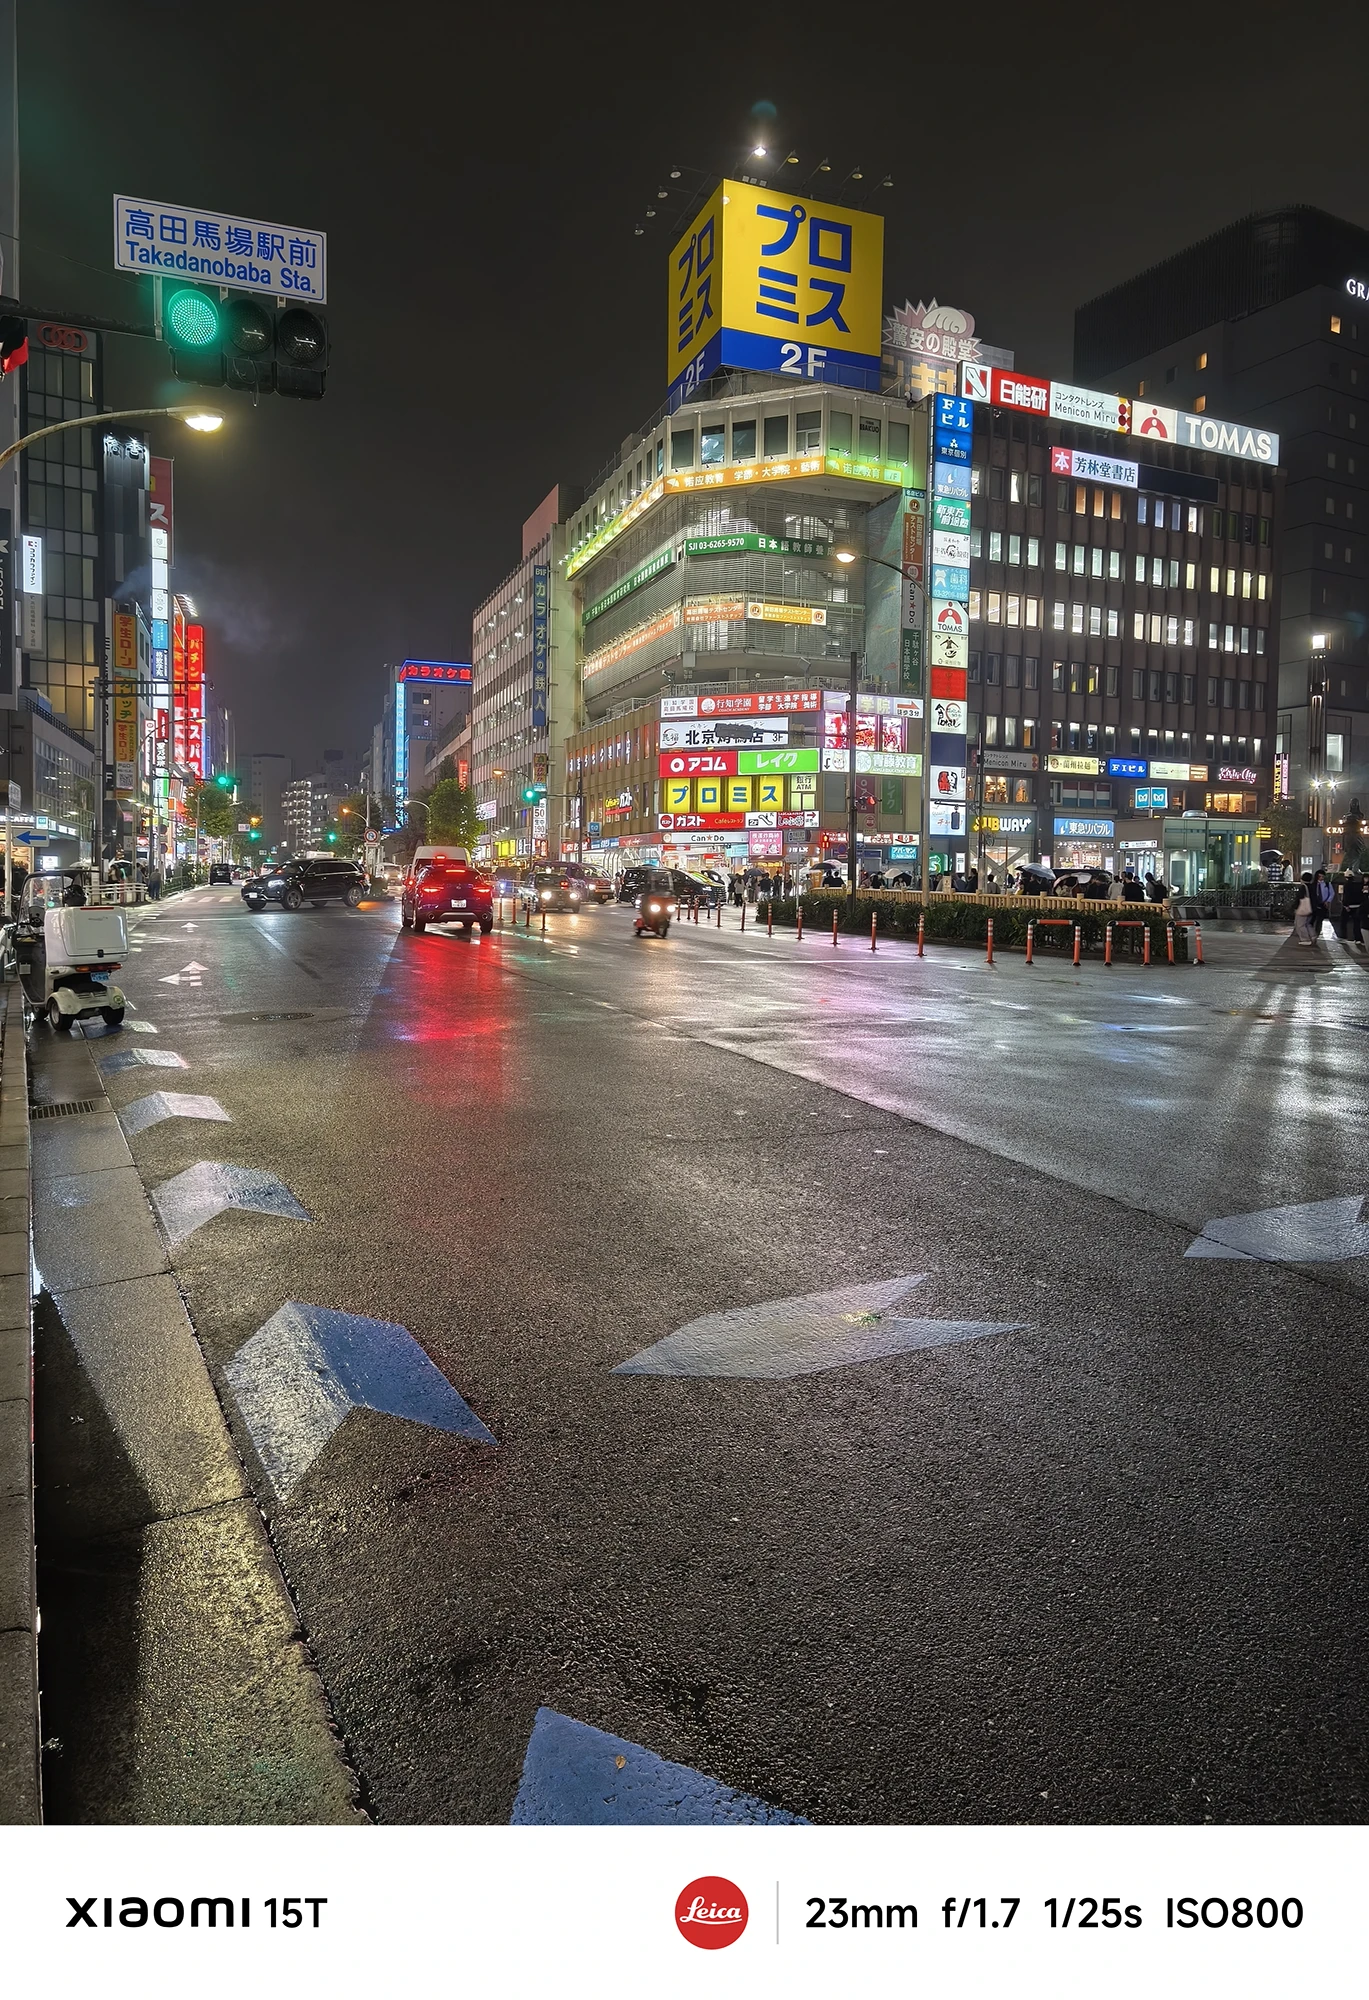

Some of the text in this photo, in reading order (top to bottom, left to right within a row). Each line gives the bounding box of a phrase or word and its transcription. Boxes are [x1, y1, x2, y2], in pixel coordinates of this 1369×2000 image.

[125, 208, 318, 269] 高田馬場駅前
[756, 204, 853, 273] プロ
[125, 240, 317, 295] Takadanobaba Sta.
[678, 215, 715, 301] プロ
[756, 266, 852, 334] ミス
[678, 276, 714, 353] ミス
[891, 321, 974, 362] 驚安の殿堂
[780, 343, 828, 377] 2F
[685, 351, 706, 395] 2F
[1000, 379, 1047, 411] 日能研
[1055, 392, 1105, 409] コンタクトレンズ
[942, 398, 967, 413] FI
[1055, 402, 1116, 424] Menicon Miru
[941, 414, 970, 428] ビル
[1186, 416, 1272, 461] TOMAS
[940, 446, 967, 460] 東京個別
[1055, 452, 1069, 471] 本
[1074, 455, 1136, 483] 芳林堂書店
[937, 484, 969, 498] 東急リバブル
[688, 537, 745, 551] SJI 03-6265-9570
[938, 623, 963, 633] TOMAS
[119, 616, 133, 667] 学生ローン
[716, 697, 752, 708] 行知学園
[688, 756, 727, 772] アコム
[756, 752, 798, 769] レイク
[672, 785, 778, 804] プロミス
[676, 816, 705, 827] ガスト
[973, 817, 1032, 833] SUBWAY
[1069, 822, 1111, 835] 東急リバブル
[691, 834, 706, 842] Can
